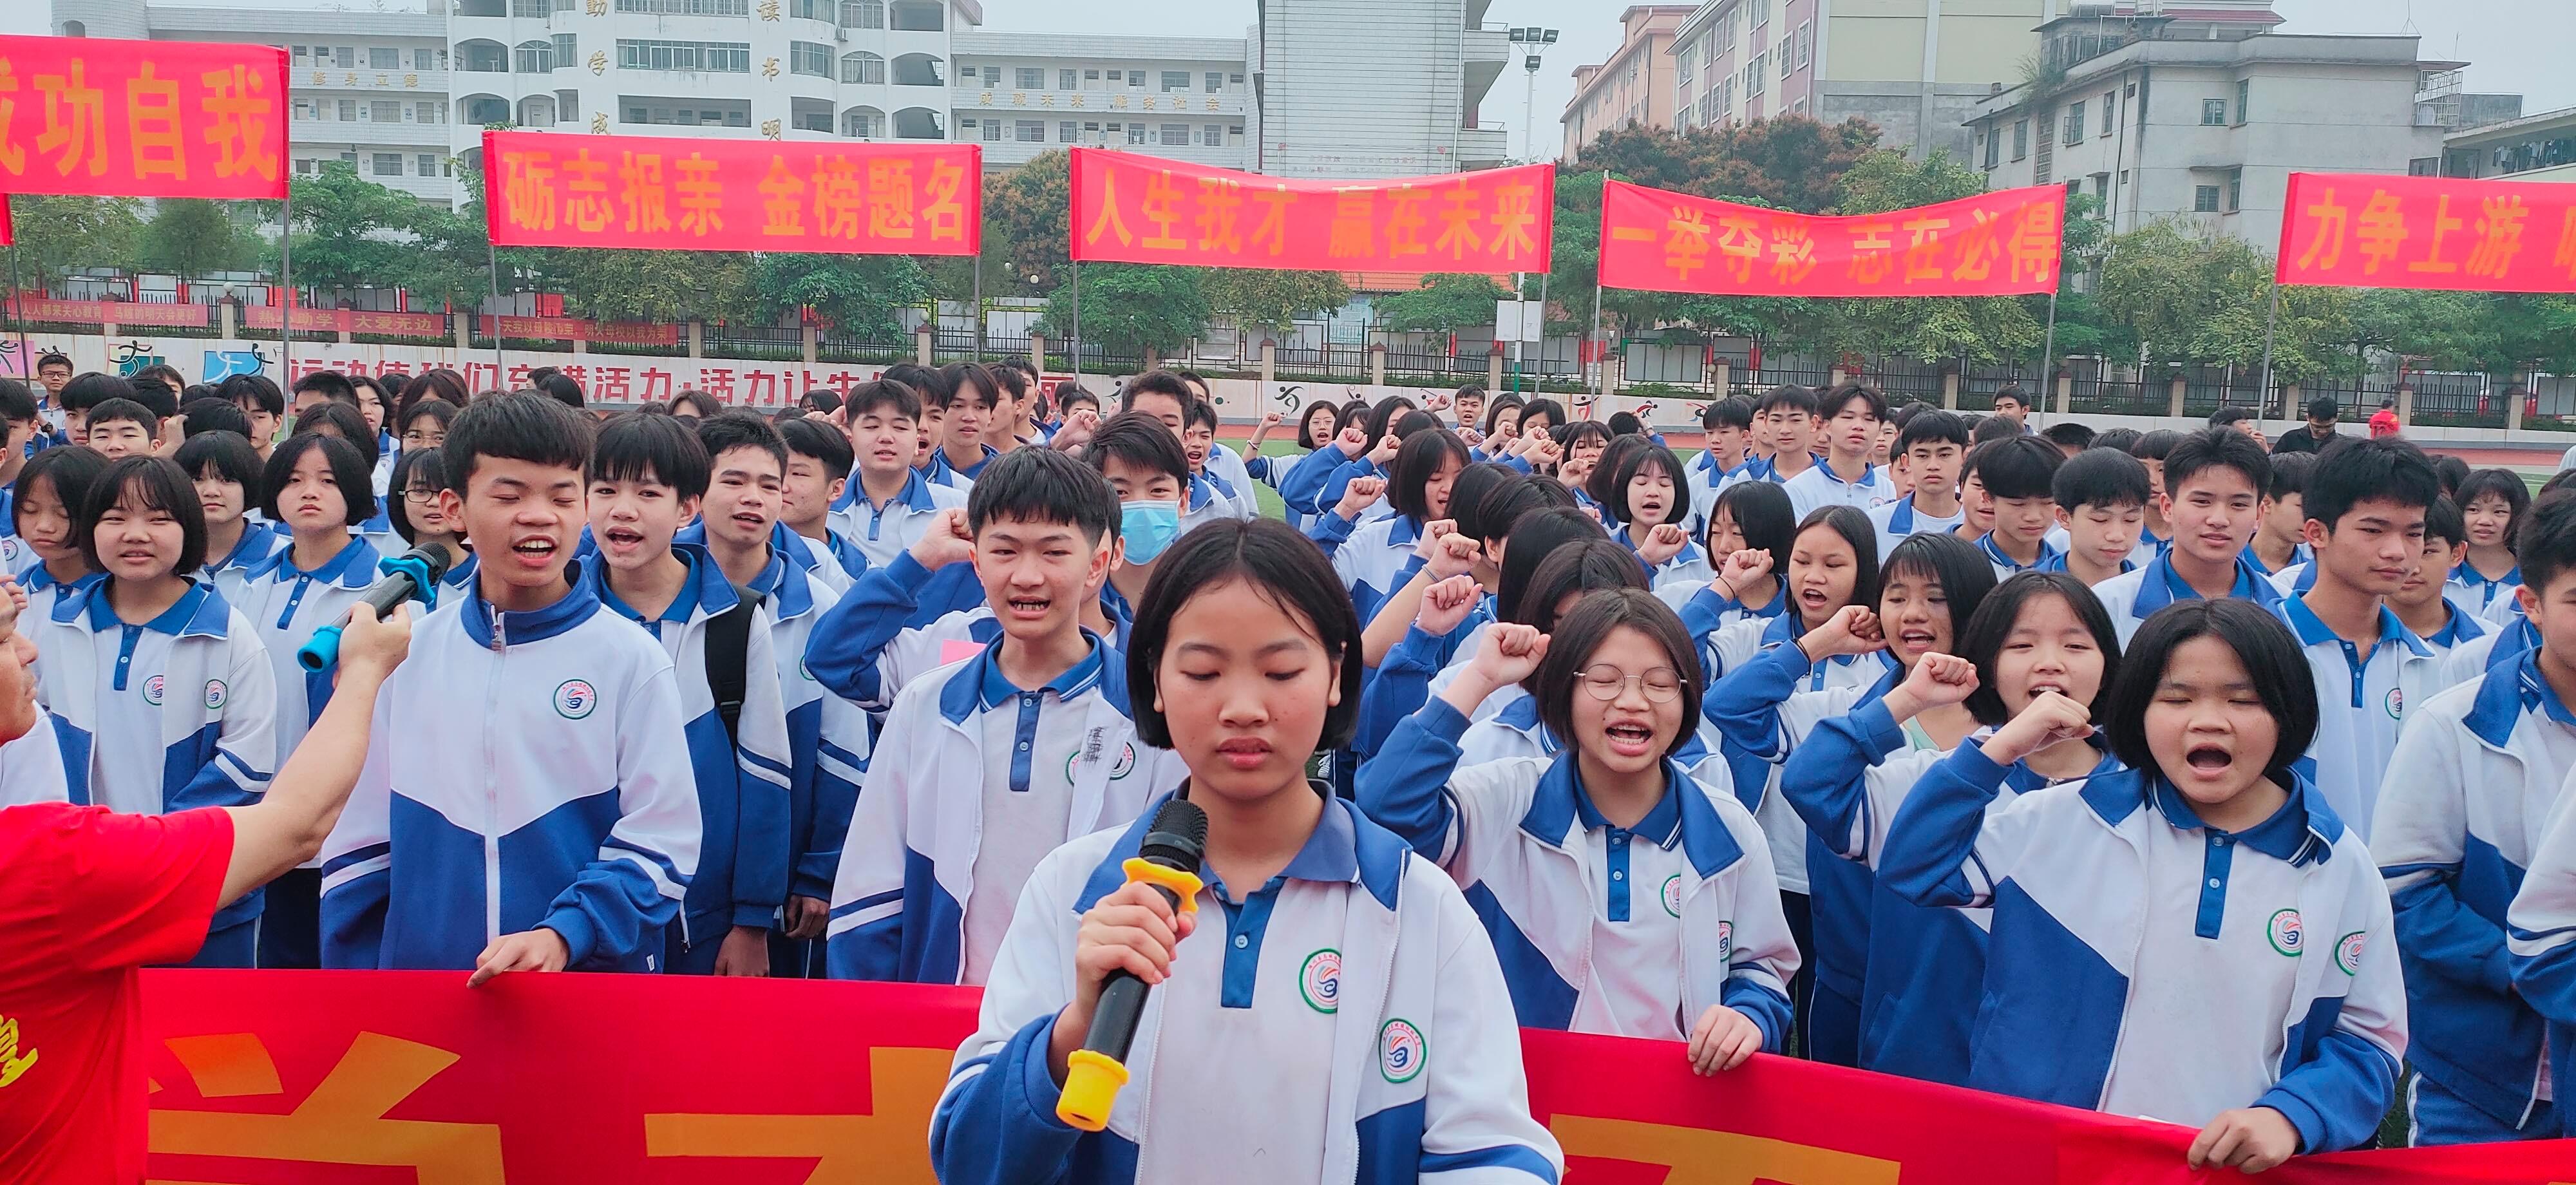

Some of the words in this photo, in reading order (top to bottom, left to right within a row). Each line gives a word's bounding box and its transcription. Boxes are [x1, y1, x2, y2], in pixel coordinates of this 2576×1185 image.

[503, 148, 724, 237] 砺志报亲
[758, 155, 963, 242] 金榜题名
[1086, 168, 1299, 256] 人生我才
[1328, 176, 1535, 261] 赢在未来
[2297, 187, 2529, 278] 力争上游
[1612, 205, 1817, 285] 一举夺彩
[1846, 201, 2058, 285] 志在必得
